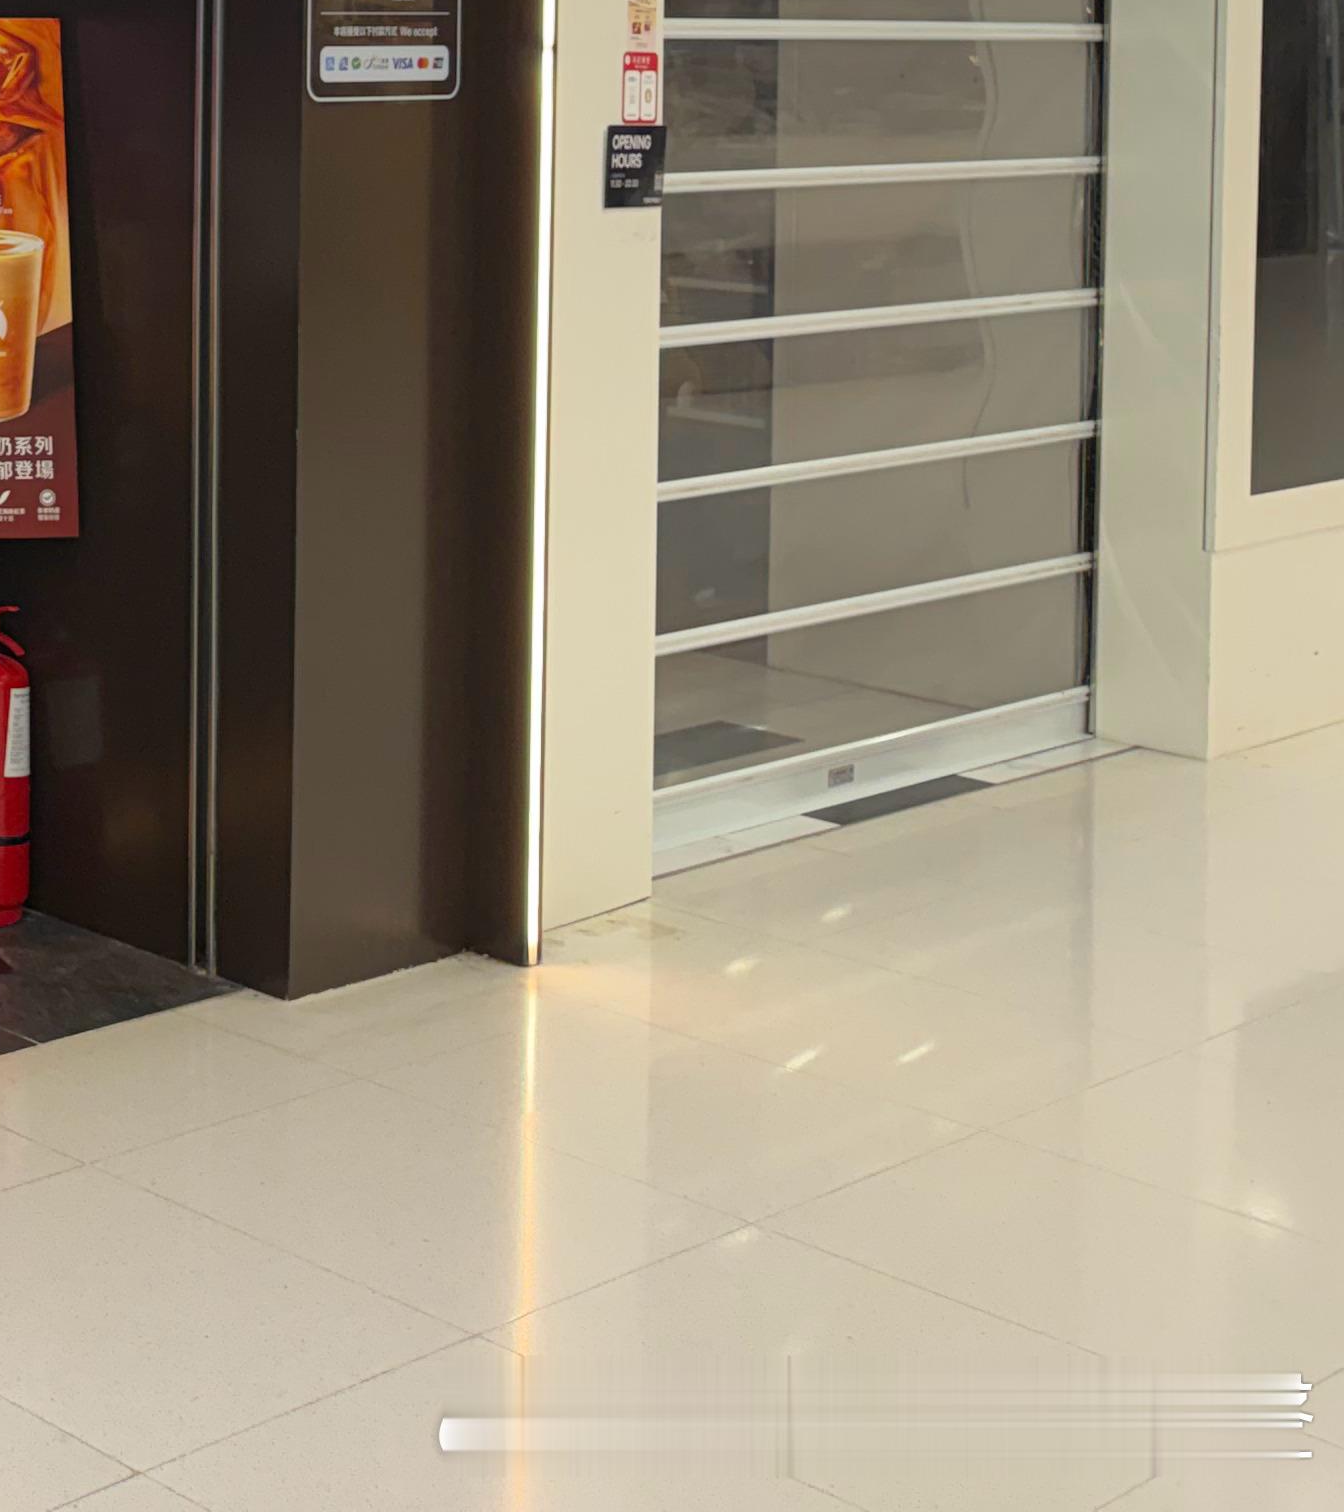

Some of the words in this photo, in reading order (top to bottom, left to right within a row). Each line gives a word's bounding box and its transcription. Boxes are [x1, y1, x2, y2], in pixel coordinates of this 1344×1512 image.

[392, 58, 413, 69] VISA
[612, 134, 651, 150] OPENING
[611, 153, 642, 168] HOURS
